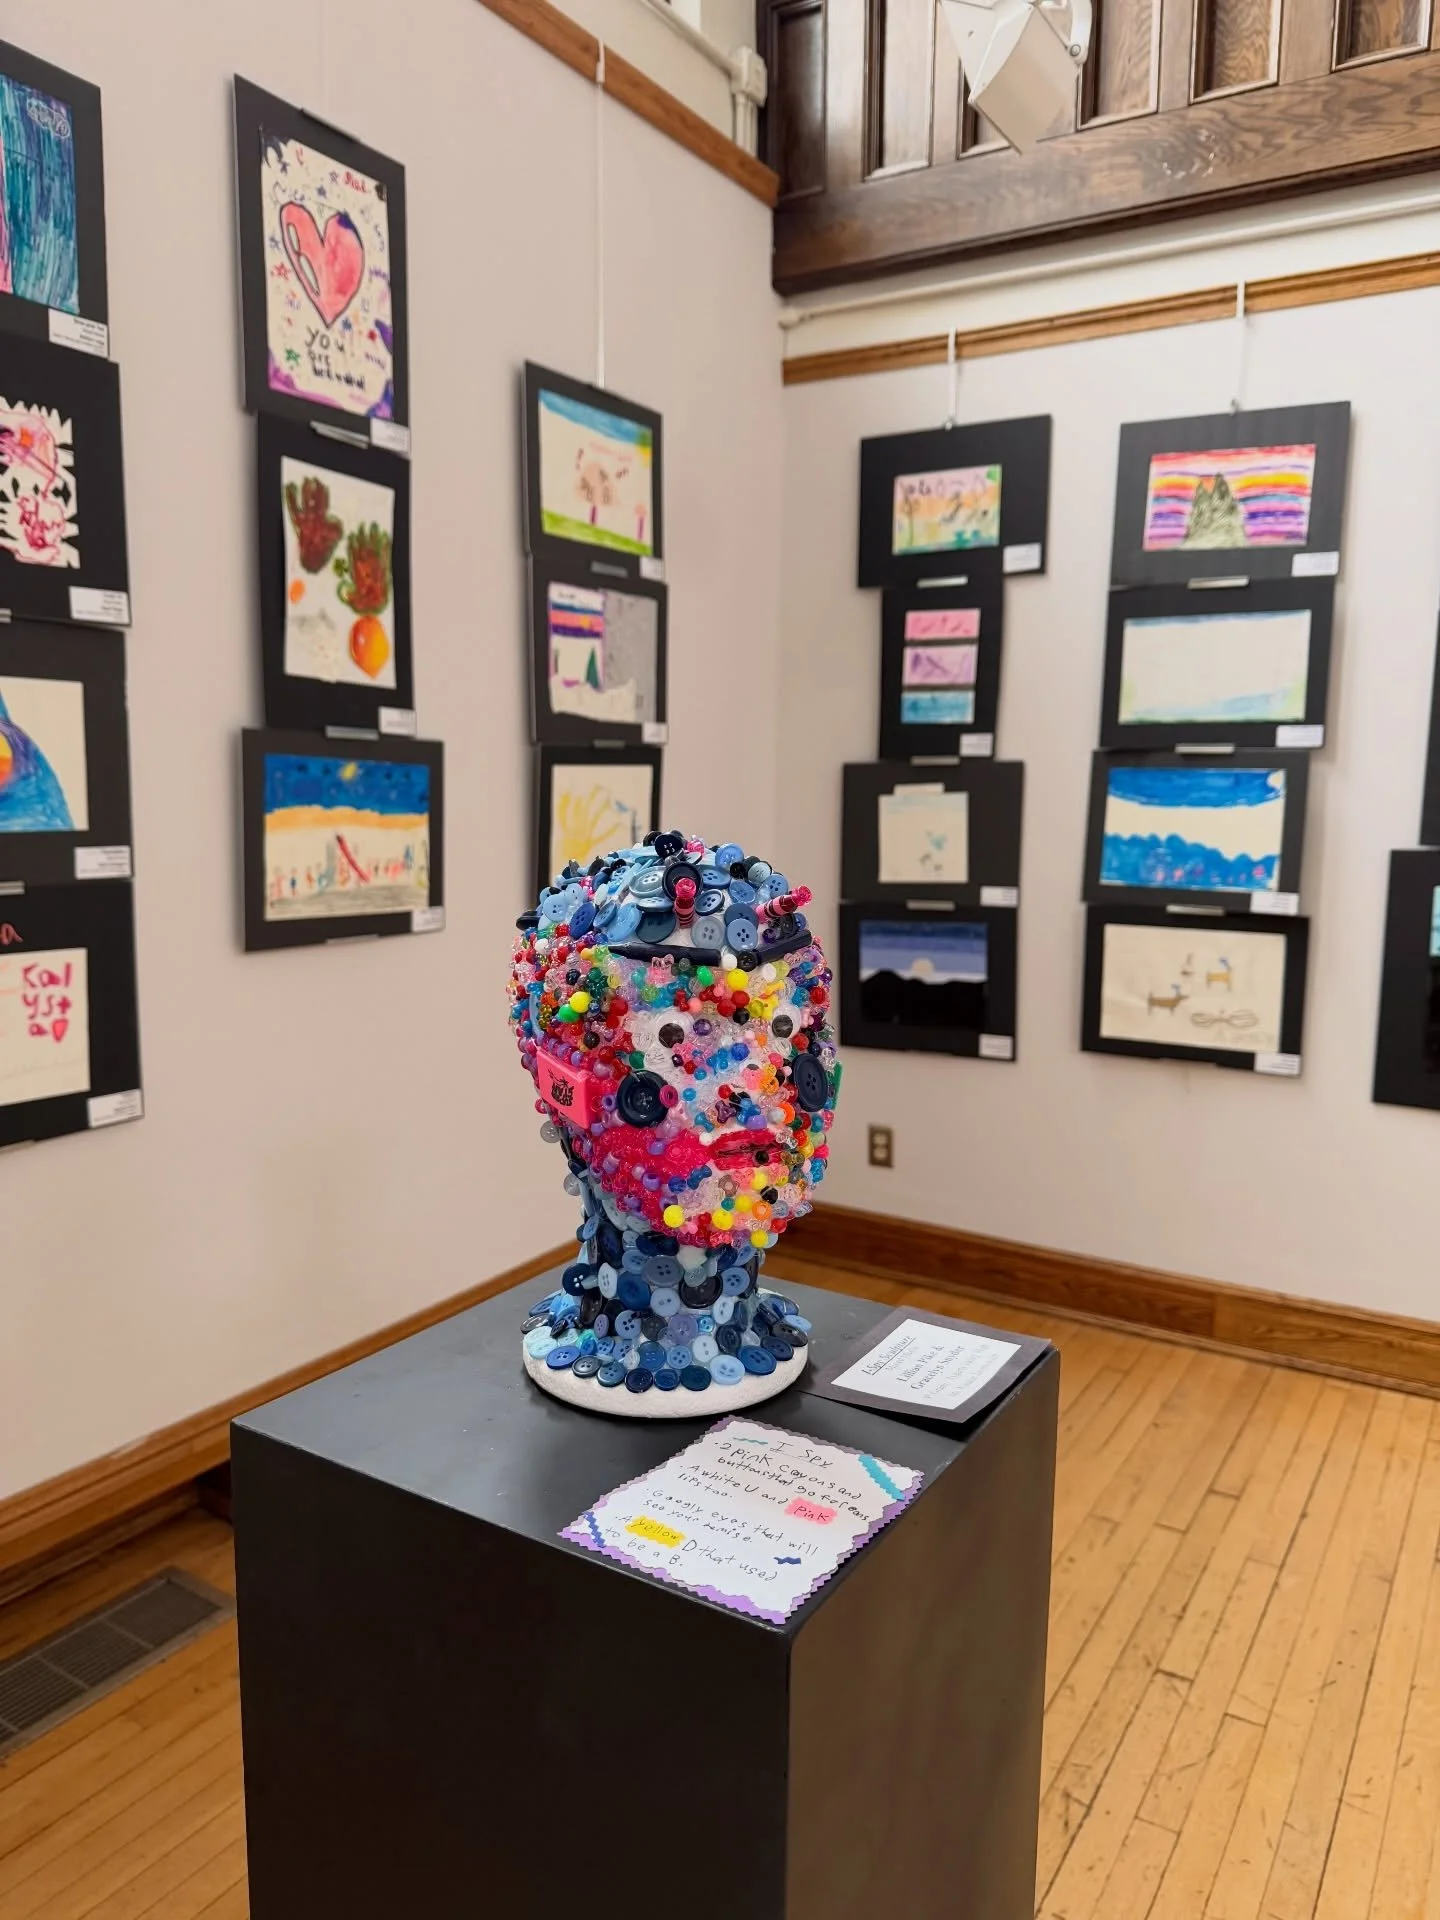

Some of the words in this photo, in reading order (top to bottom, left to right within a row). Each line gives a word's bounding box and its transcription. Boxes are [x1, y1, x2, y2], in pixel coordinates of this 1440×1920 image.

[719, 1442, 732, 1451] 2
[838, 1487, 862, 1500] and
[769, 1440, 793, 1452] I
[799, 1449, 834, 1469] Spy
[688, 1464, 700, 1473] A
[701, 1469, 741, 1489] white
[744, 1484, 760, 1493] U
[761, 1492, 789, 1505] and
[796, 1485, 816, 1498] go
[820, 1494, 848, 1509] for
[605, 1526, 622, 1539] to
[627, 1537, 648, 1552] be
[652, 1551, 662, 1559] a
[788, 1541, 822, 1556] will
[682, 1539, 699, 1552] D
[698, 1544, 738, 1565] that
[739, 1562, 779, 1582] used
